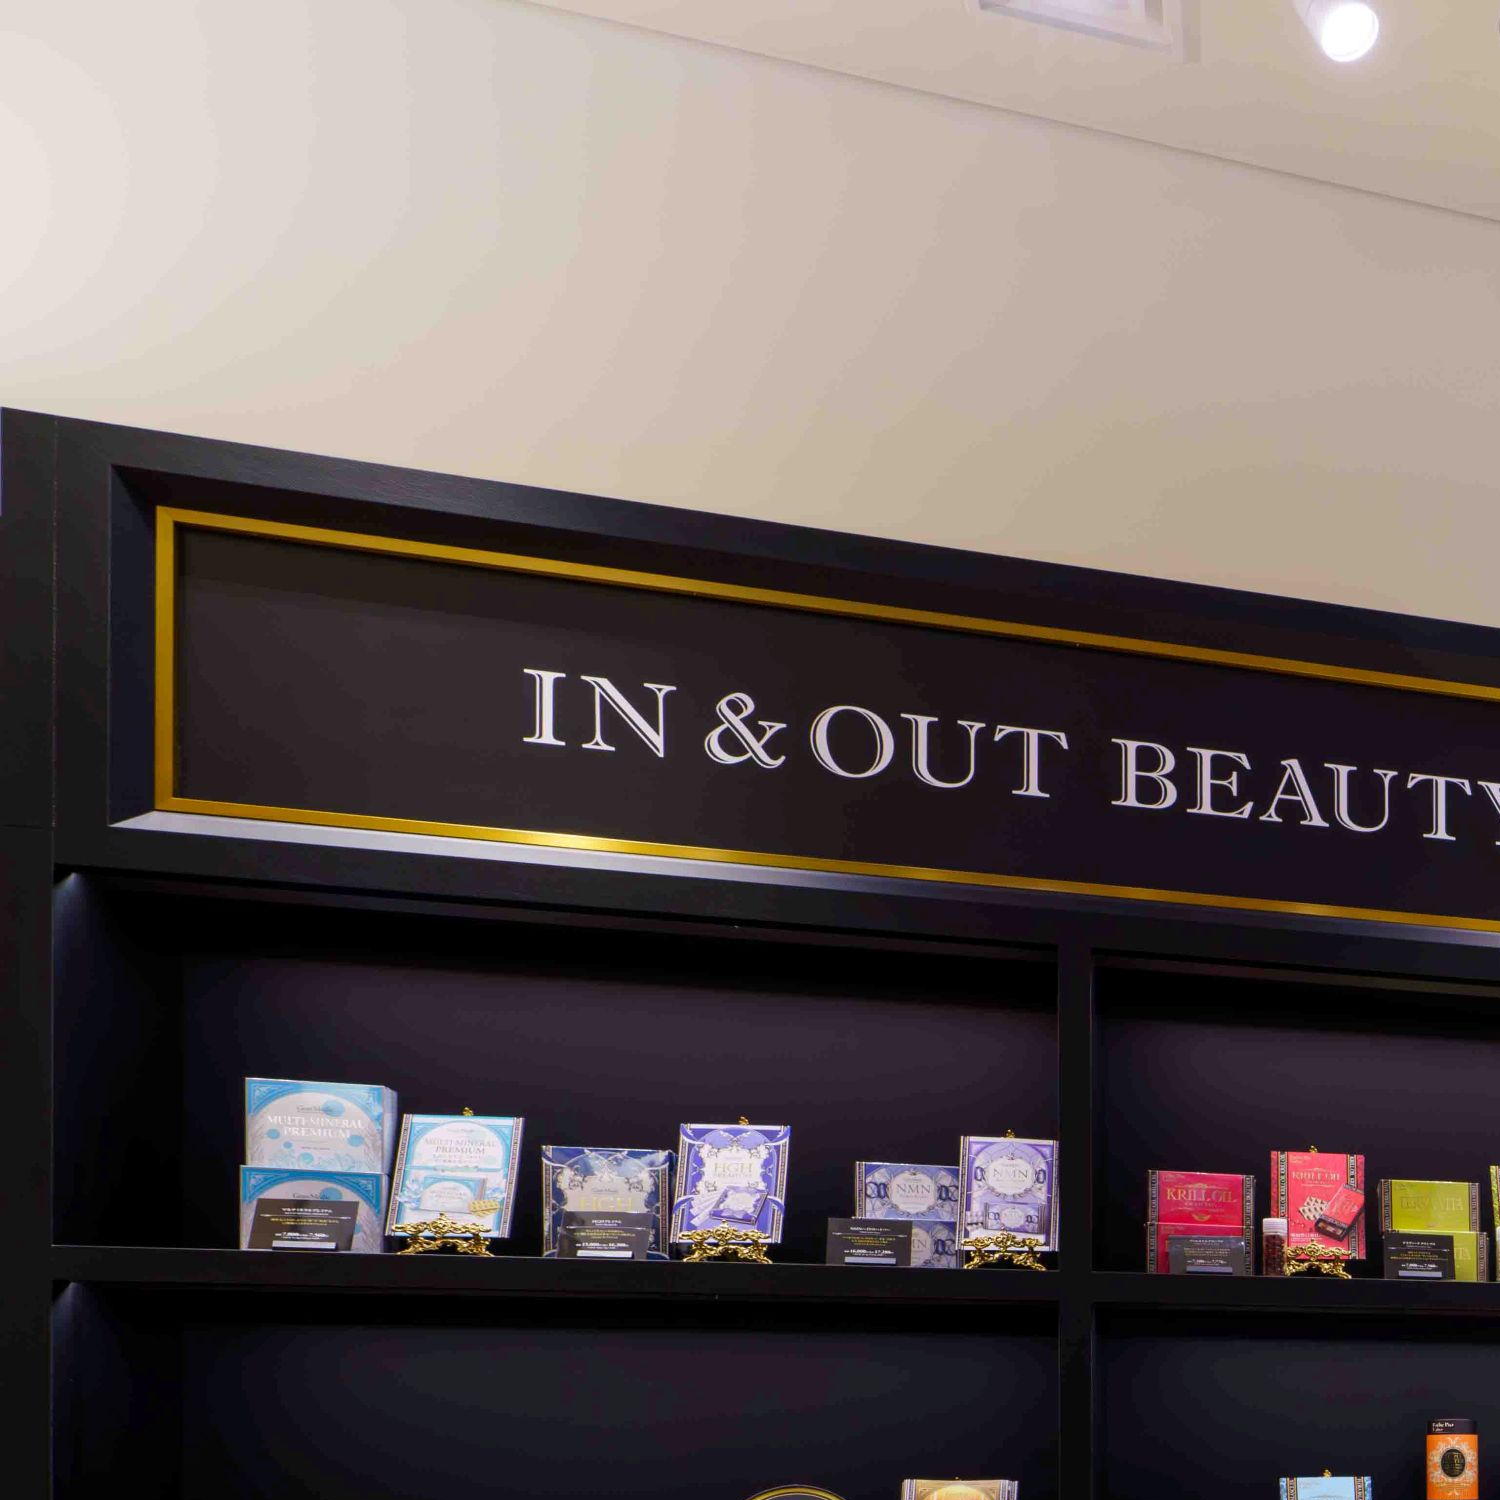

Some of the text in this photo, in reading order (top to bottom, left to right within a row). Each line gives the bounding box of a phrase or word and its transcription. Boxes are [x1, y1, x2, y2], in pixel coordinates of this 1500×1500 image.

[523, 668, 677, 758] IN
[703, 691, 787, 769] &
[810, 705, 1069, 798] OUT
[896, 1183, 931, 1194] NMN
